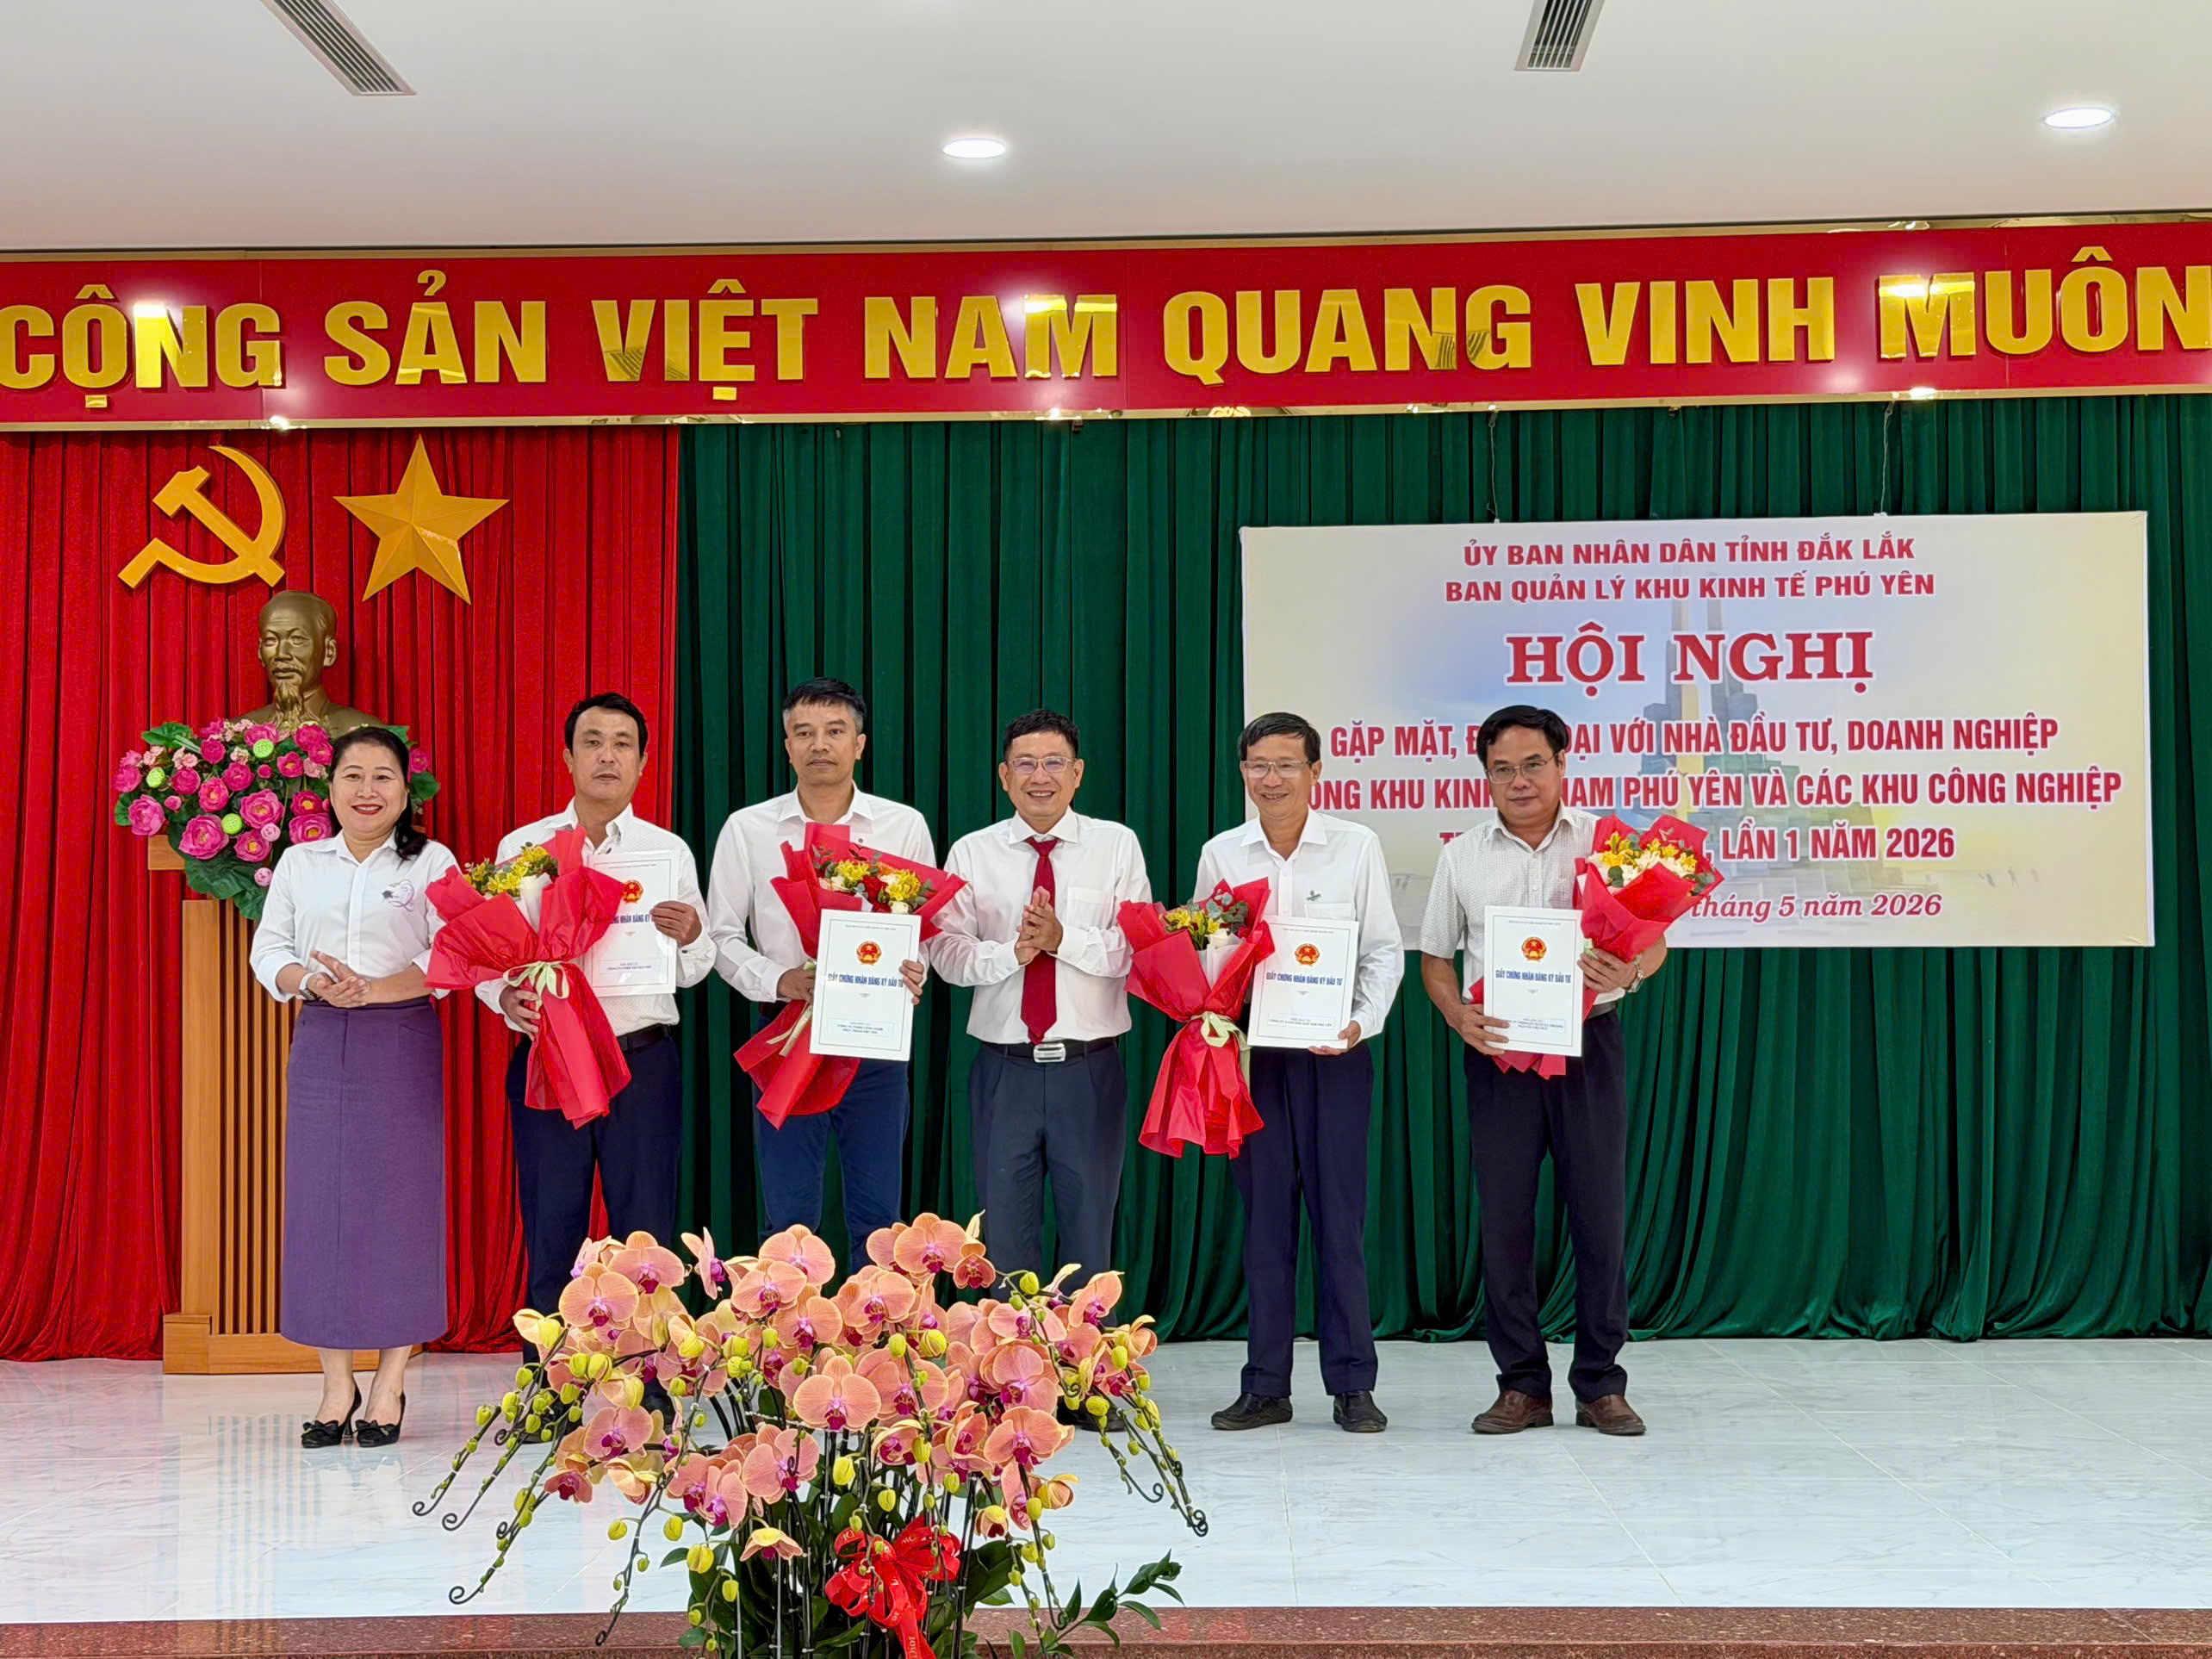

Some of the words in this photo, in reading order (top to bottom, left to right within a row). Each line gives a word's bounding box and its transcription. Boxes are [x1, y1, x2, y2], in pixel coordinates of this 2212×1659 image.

[0, 283, 283, 407] CỘNG
[324, 270, 546, 386] SẢN
[592, 279, 818, 401] VIỆT
[864, 294, 1117, 379] NAM
[1164, 284, 1531, 385] QUANG
[1575, 276, 1835, 366] VINH
[1879, 246, 2212, 359] MUÔN
[1463, 539, 1499, 567] ỦY
[1507, 544, 1564, 565] BAN
[1573, 539, 1650, 565] NHÂN
[1659, 538, 1717, 564] DÂN
[1725, 535, 1789, 563] TỈNH
[1797, 532, 1855, 562] ĐẮK
[1863, 531, 1915, 561] LẮK
[1446, 581, 1502, 602] BAN
[1512, 573, 1586, 603] QUẢN
[1596, 575, 1625, 600] LÝ
[1635, 579, 1690, 600] KHU
[1699, 578, 1766, 600] KINH
[1775, 569, 1807, 599] TẾ
[1816, 571, 1872, 598] PHÚ
[1880, 570, 1936, 597] YÊN
[1507, 621, 1646, 697] HỘI
[1674, 631, 1873, 694] NGHỊ
[1331, 720, 1385, 763] GẶP
[1395, 719, 1457, 762] MẶT,
[1610, 717, 1655, 755] VỚI
[1664, 716, 1722, 754] NHÀ
[1730, 711, 1787, 753] ĐẦU
[1796, 718, 1839, 755] TƯ,
[1848, 720, 1944, 752] DOANH
[1954, 712, 2060, 756] NGHIỆP
[1309, 780, 1361, 810] ONG
[1370, 779, 1426, 810] KHU
[1624, 770, 1680, 807] PHÚ
[1689, 769, 1743, 807] YÊN
[1752, 768, 1788, 806] VÀ
[1796, 767, 1853, 806] CÁC
[1862, 774, 1919, 805] KHU
[1929, 767, 2007, 805] CÔNG
[2016, 766, 2122, 811] NGHIỆP
[1723, 817, 1776, 860] LẦN
[1786, 830, 1798, 860] 1
[1811, 822, 1878, 860] NĂM
[1886, 828, 1956, 860] 2026
[1779, 896, 1796, 917] 5
[1805, 893, 1863, 916] năm
[1871, 895, 1942, 916] 2026
